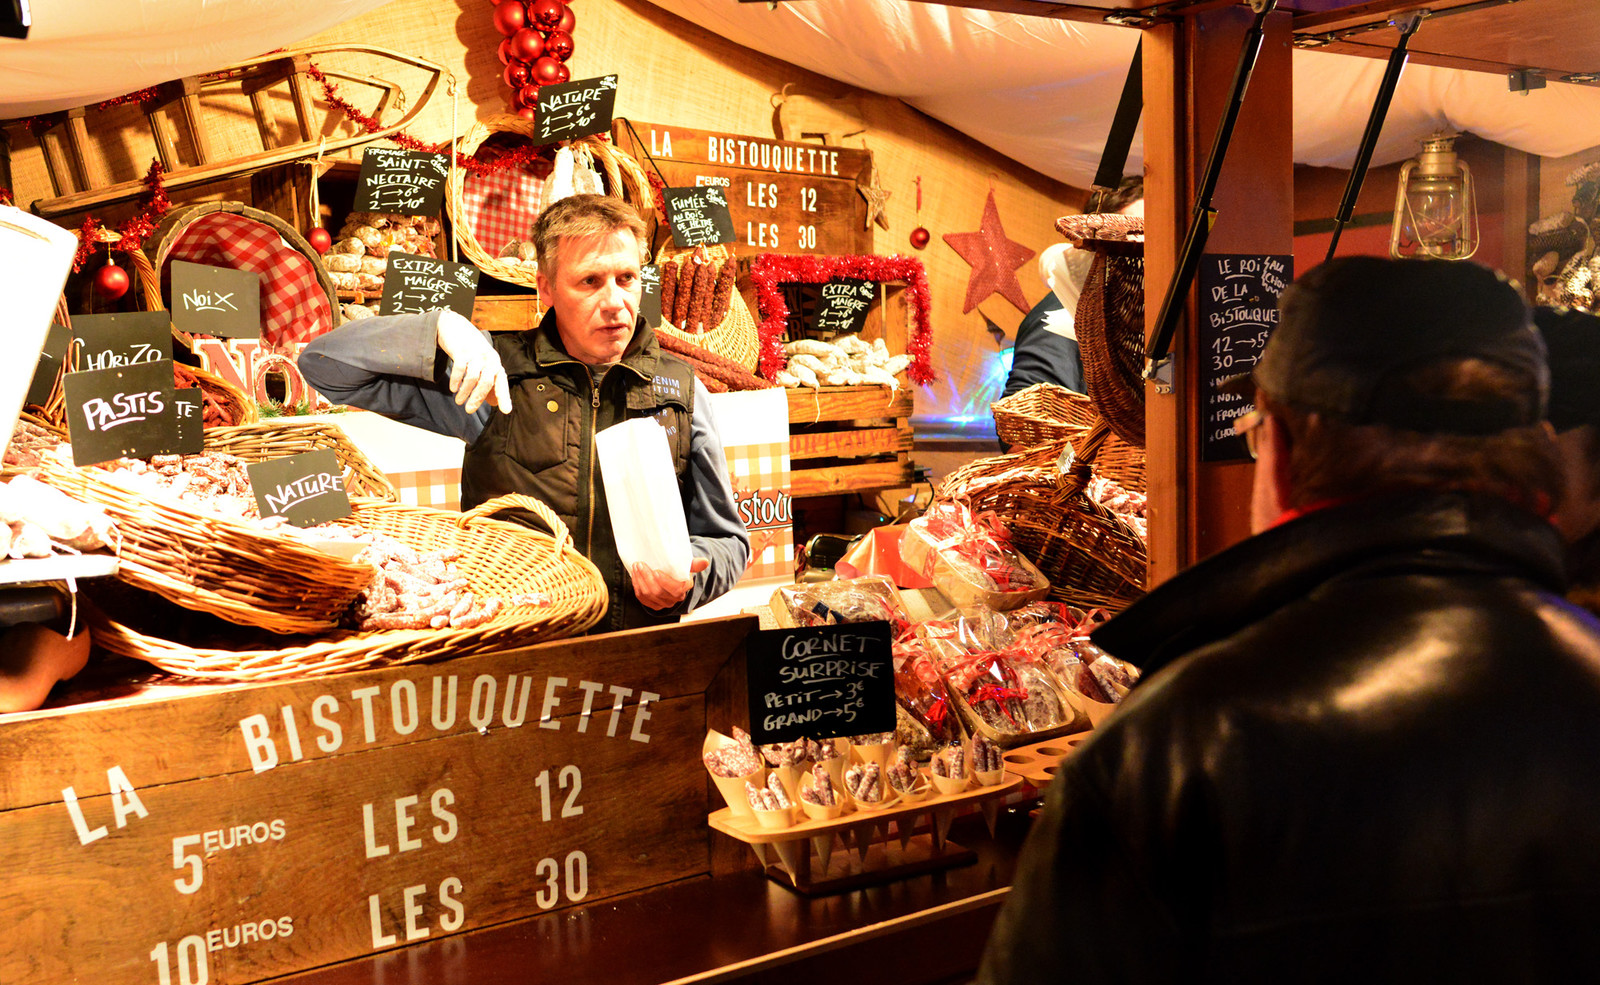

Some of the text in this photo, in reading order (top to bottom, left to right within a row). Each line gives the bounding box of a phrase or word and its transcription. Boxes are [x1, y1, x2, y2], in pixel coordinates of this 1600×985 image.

[542, 116, 551, 125] 1
[541, 127, 552, 138] 2
[650, 129, 839, 176] LA BISTOUQUETTE
[704, 176, 730, 187] EUROS
[370, 190, 380, 199] 1
[671, 193, 708, 211] FUMÉE
[747, 182, 817, 212] LES 12
[369, 200, 380, 210] 2
[686, 239, 695, 247] 2
[747, 222, 816, 249] LES 30
[393, 258, 444, 276] EXTRA
[1218, 259, 1232, 275] LE
[1269, 260, 1284, 273] AU
[392, 291, 403, 300] 1
[822, 283, 857, 296] EXTRA
[1211, 283, 1248, 302] DE LA
[392, 302, 405, 313] 2
[820, 308, 829, 317] 1
[818, 319, 826, 328] 2
[1212, 336, 1233, 354] 12
[1212, 355, 1233, 371] 30
[264, 473, 343, 513] NATURE
[782, 634, 881, 660] CORNET
[846, 680, 865, 700] 3€
[763, 697, 865, 731] GRAND 5€
[61, 674, 660, 846] LA BISTOUQUETTE
[363, 764, 584, 859] LES 12
[172, 819, 286, 894] 5 EUROS
[368, 850, 588, 949] LES 30
[150, 916, 294, 985] 10 EUROS
